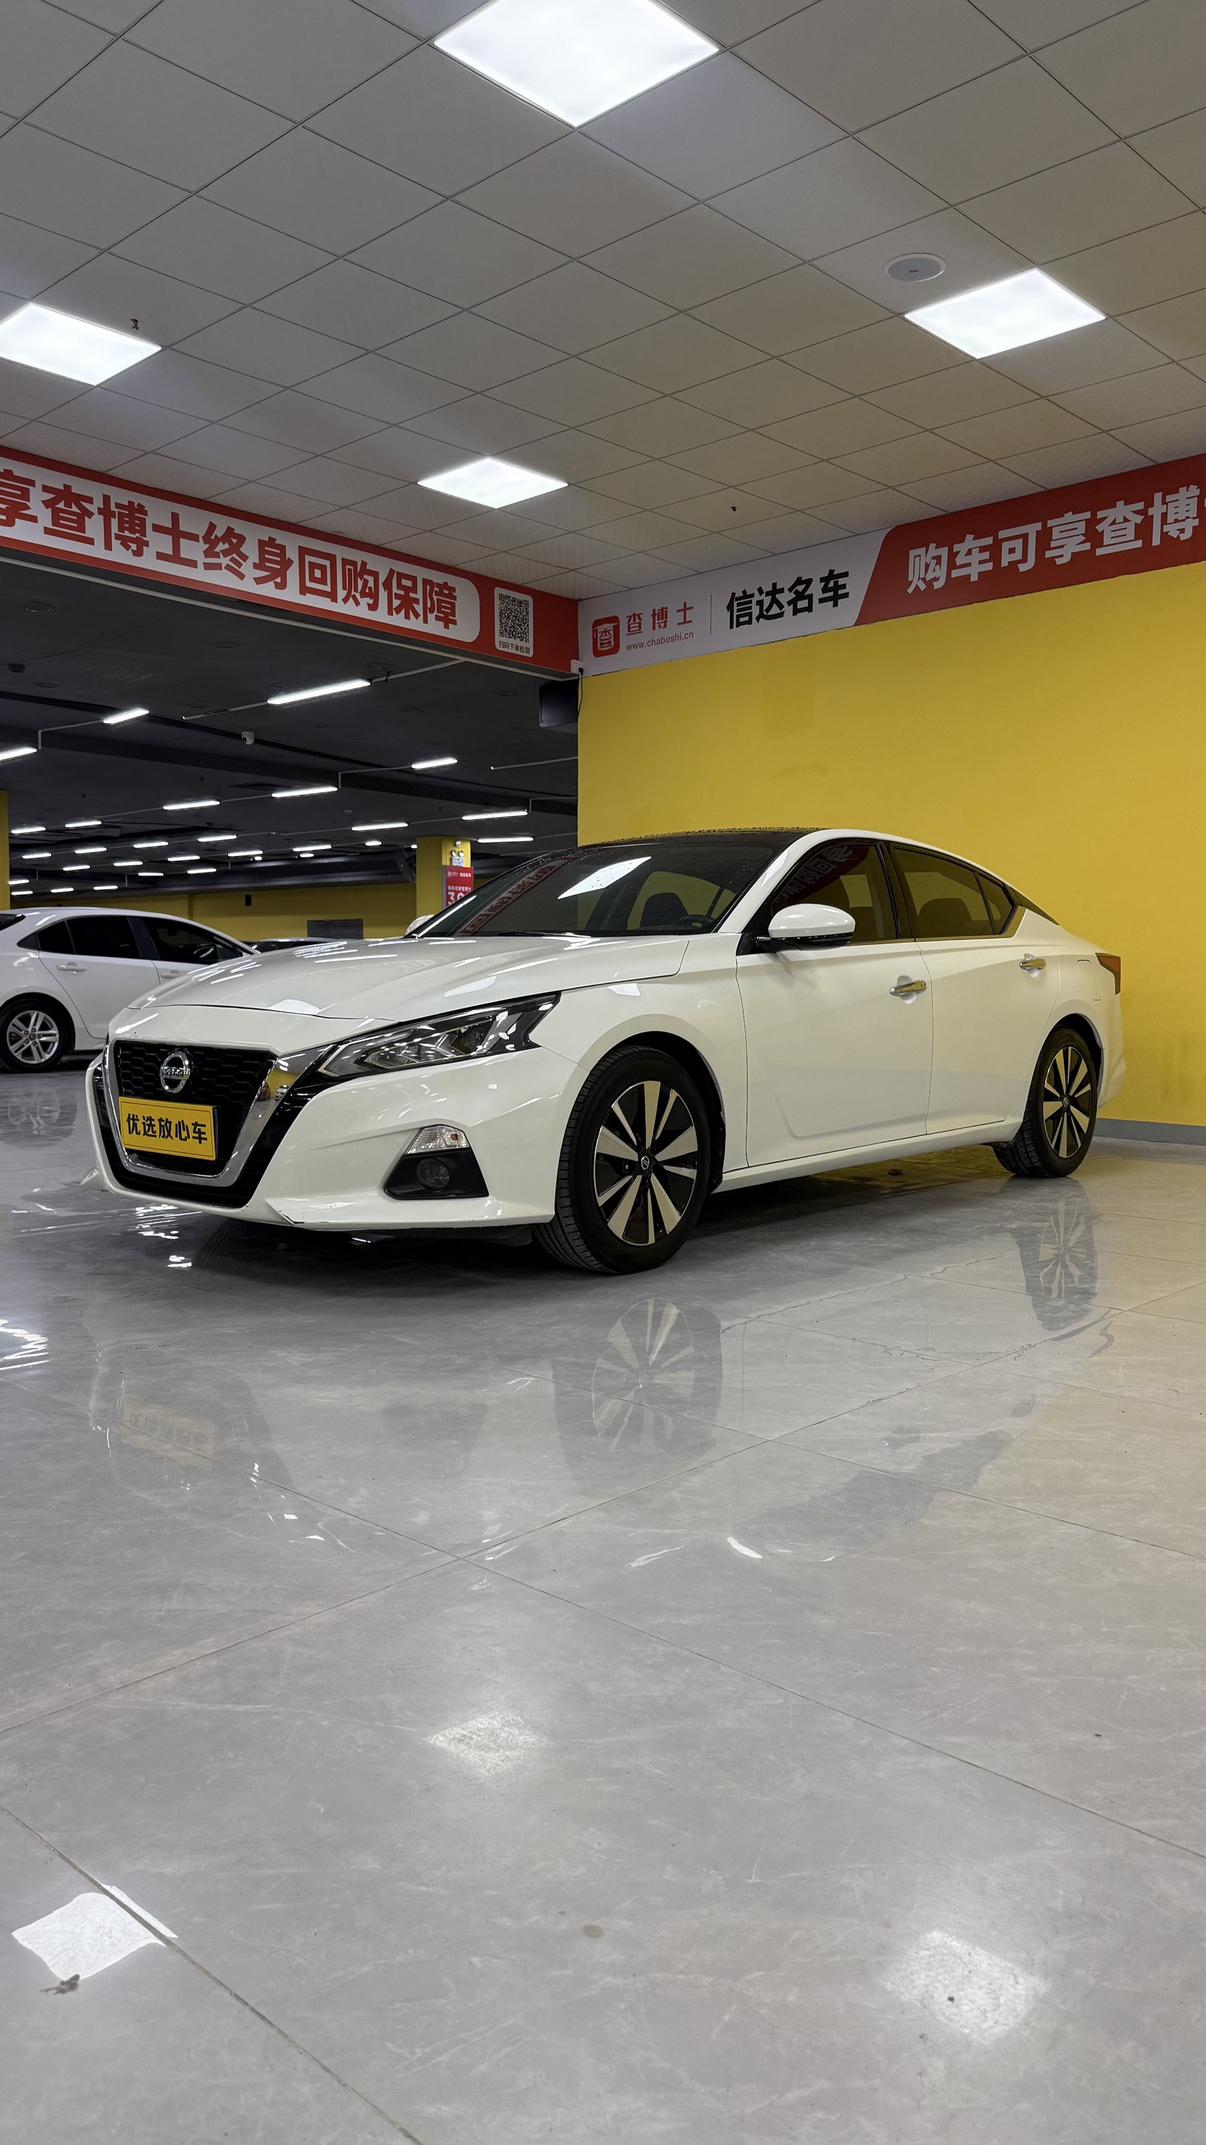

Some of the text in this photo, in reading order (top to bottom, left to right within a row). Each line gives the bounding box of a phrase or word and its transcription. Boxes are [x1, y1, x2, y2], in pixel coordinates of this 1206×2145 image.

[0, 469, 457, 630] 享查博士终身回购保障
[906, 484, 1206, 594] 购车可享查博
[626, 602, 695, 636] 查博士
[726, 569, 850, 630] 信达名车
[626, 631, 695, 652] www.chaboshi.cn
[126, 1113, 208, 1144] 优选放心车
